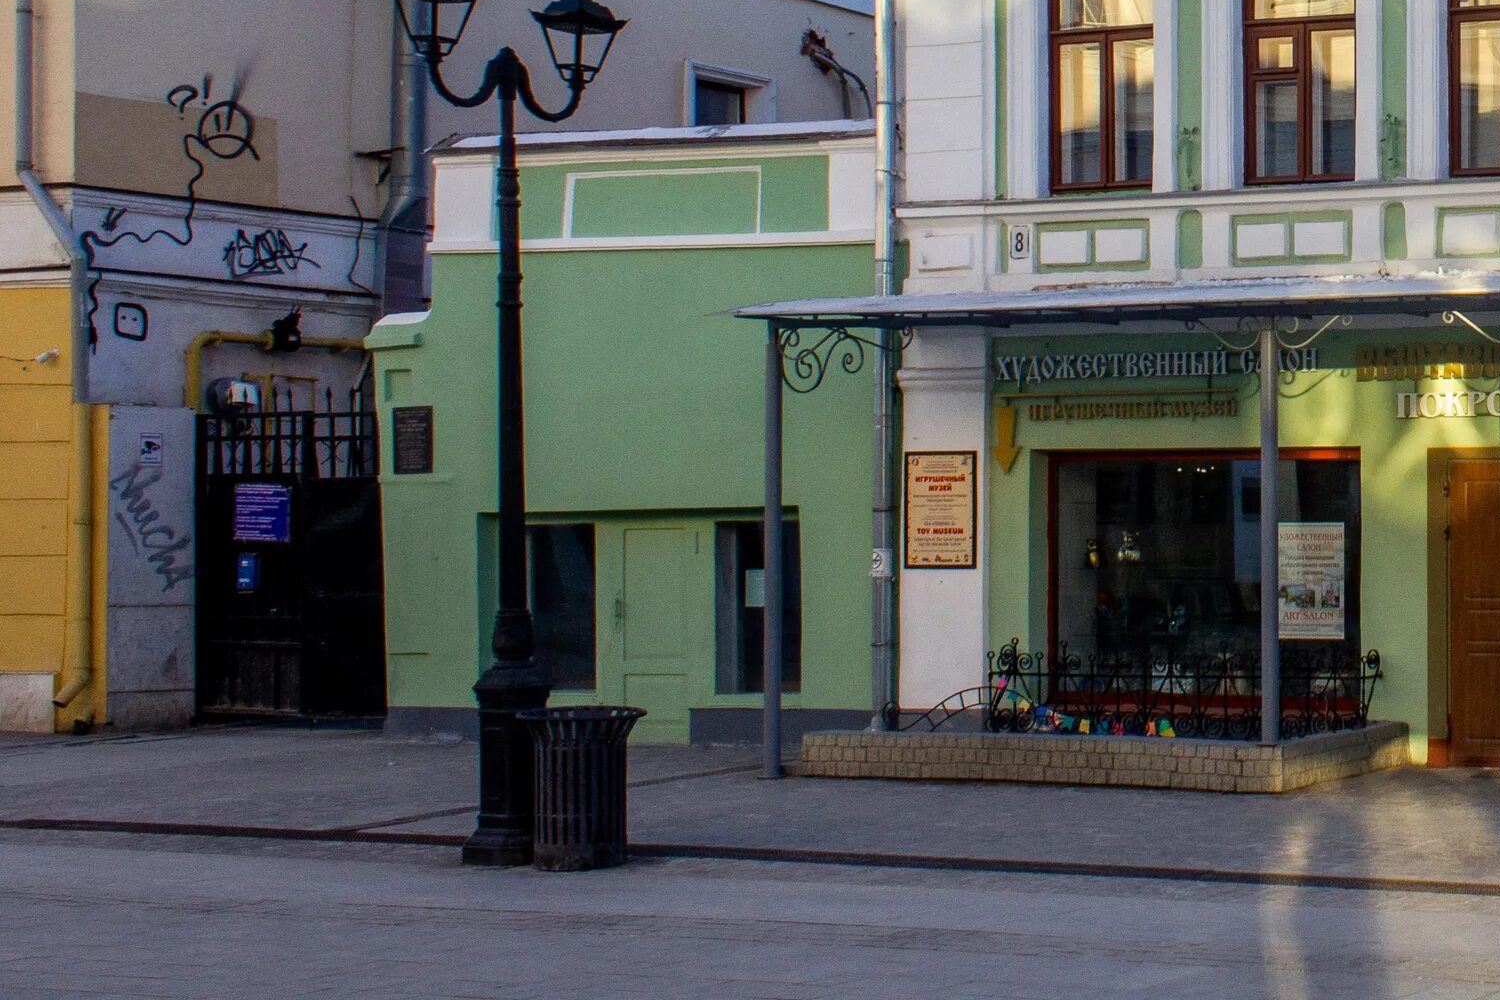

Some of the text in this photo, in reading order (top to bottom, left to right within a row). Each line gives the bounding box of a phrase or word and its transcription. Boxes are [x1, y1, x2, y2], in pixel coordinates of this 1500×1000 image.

[1015, 231, 1024, 253] 8
[996, 344, 1228, 388] ХУДОЖЕСТВЕННЫЙ
[915, 473, 966, 483] ИГРУШЕЧНЫЙ
[928, 482, 953, 492] МУЗЕЙ
[917, 527, 964, 535] TOY MUSEUM
[1284, 611, 1334, 620] ART SALON
